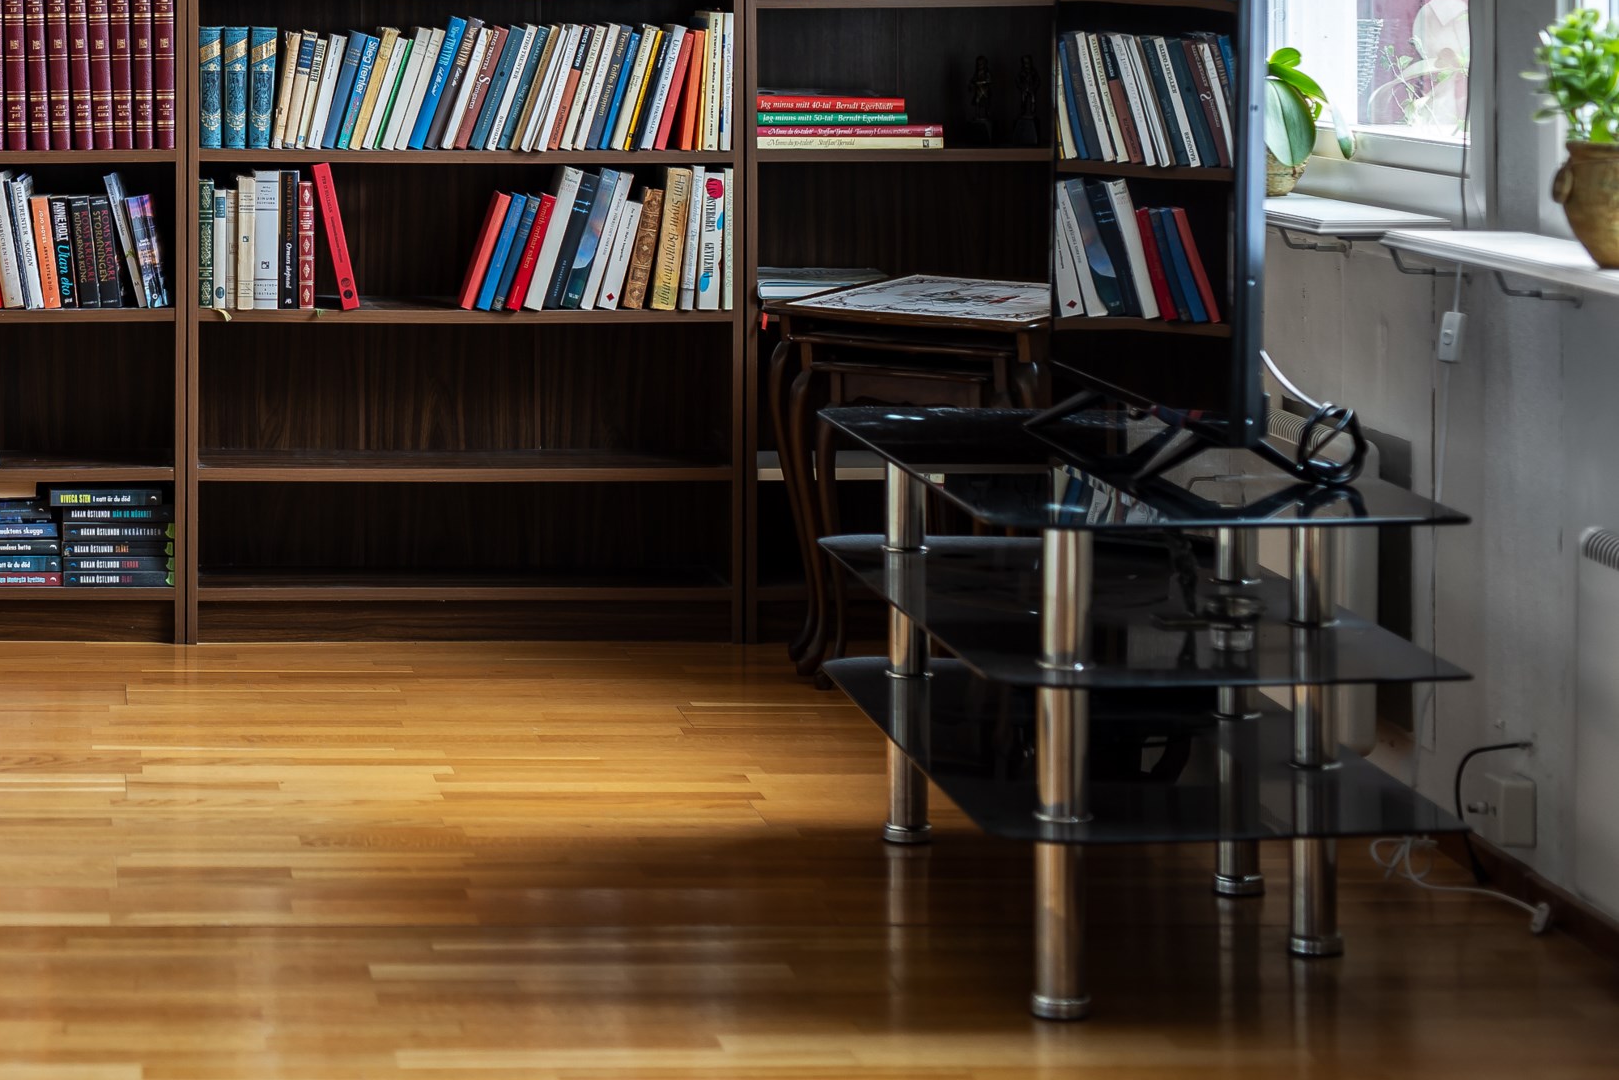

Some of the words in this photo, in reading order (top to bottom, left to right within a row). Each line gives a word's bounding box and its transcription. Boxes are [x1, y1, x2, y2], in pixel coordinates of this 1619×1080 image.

[490, 30, 500, 47] STIEG
[522, 31, 533, 51] STIEG
[614, 31, 629, 57] Trenter
[363, 41, 378, 63] Stieg
[482, 47, 494, 70] TRENTER
[513, 51, 527, 80] TRENTER
[607, 63, 619, 84] Tolfte
[356, 64, 372, 94] Trenter
[598, 84, 614, 116] knappen
[761, 100, 771, 109] Jag
[773, 101, 794, 109] minns
[812, 101, 831, 109] 40-tal
[53, 202, 66, 221] ANNE
[538, 201, 551, 225] Psmith
[57, 222, 68, 241] HOLT
[529, 226, 543, 249] ordnar
[57, 245, 71, 274] Utan
[523, 250, 535, 269] saken
[61, 277, 73, 295] eko
[60, 494, 77, 503] VIVECA
[79, 494, 91, 503] STEN
